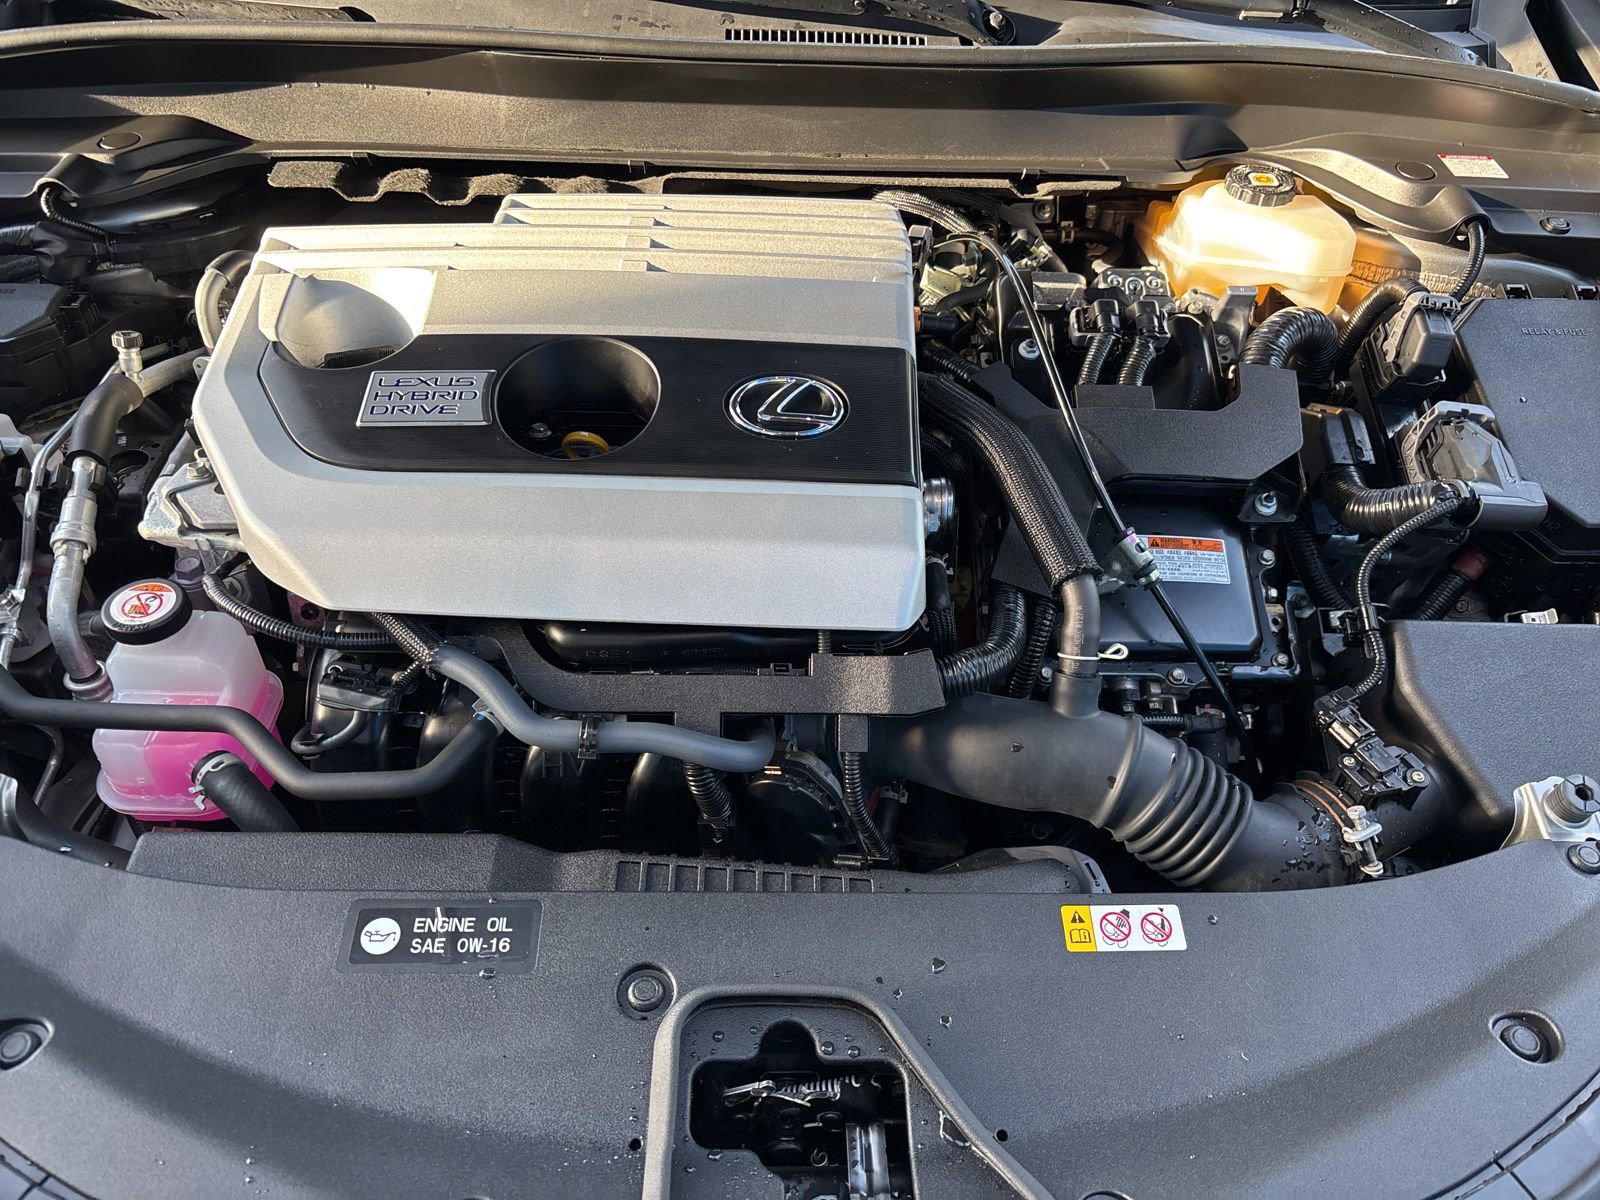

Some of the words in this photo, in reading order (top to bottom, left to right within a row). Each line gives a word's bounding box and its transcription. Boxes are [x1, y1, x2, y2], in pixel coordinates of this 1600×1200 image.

[1521, 327, 1552, 336] RELAY
[1563, 328, 1588, 337] FUSE
[378, 376, 477, 387] LEXUS
[373, 390, 480, 401] HYBRID
[369, 403, 460, 415] DRIVE
[413, 917, 477, 933] ENGINE
[486, 917, 513, 932] OIL
[410, 938, 446, 954] SAE
[457, 937, 511, 953] 0W-16
